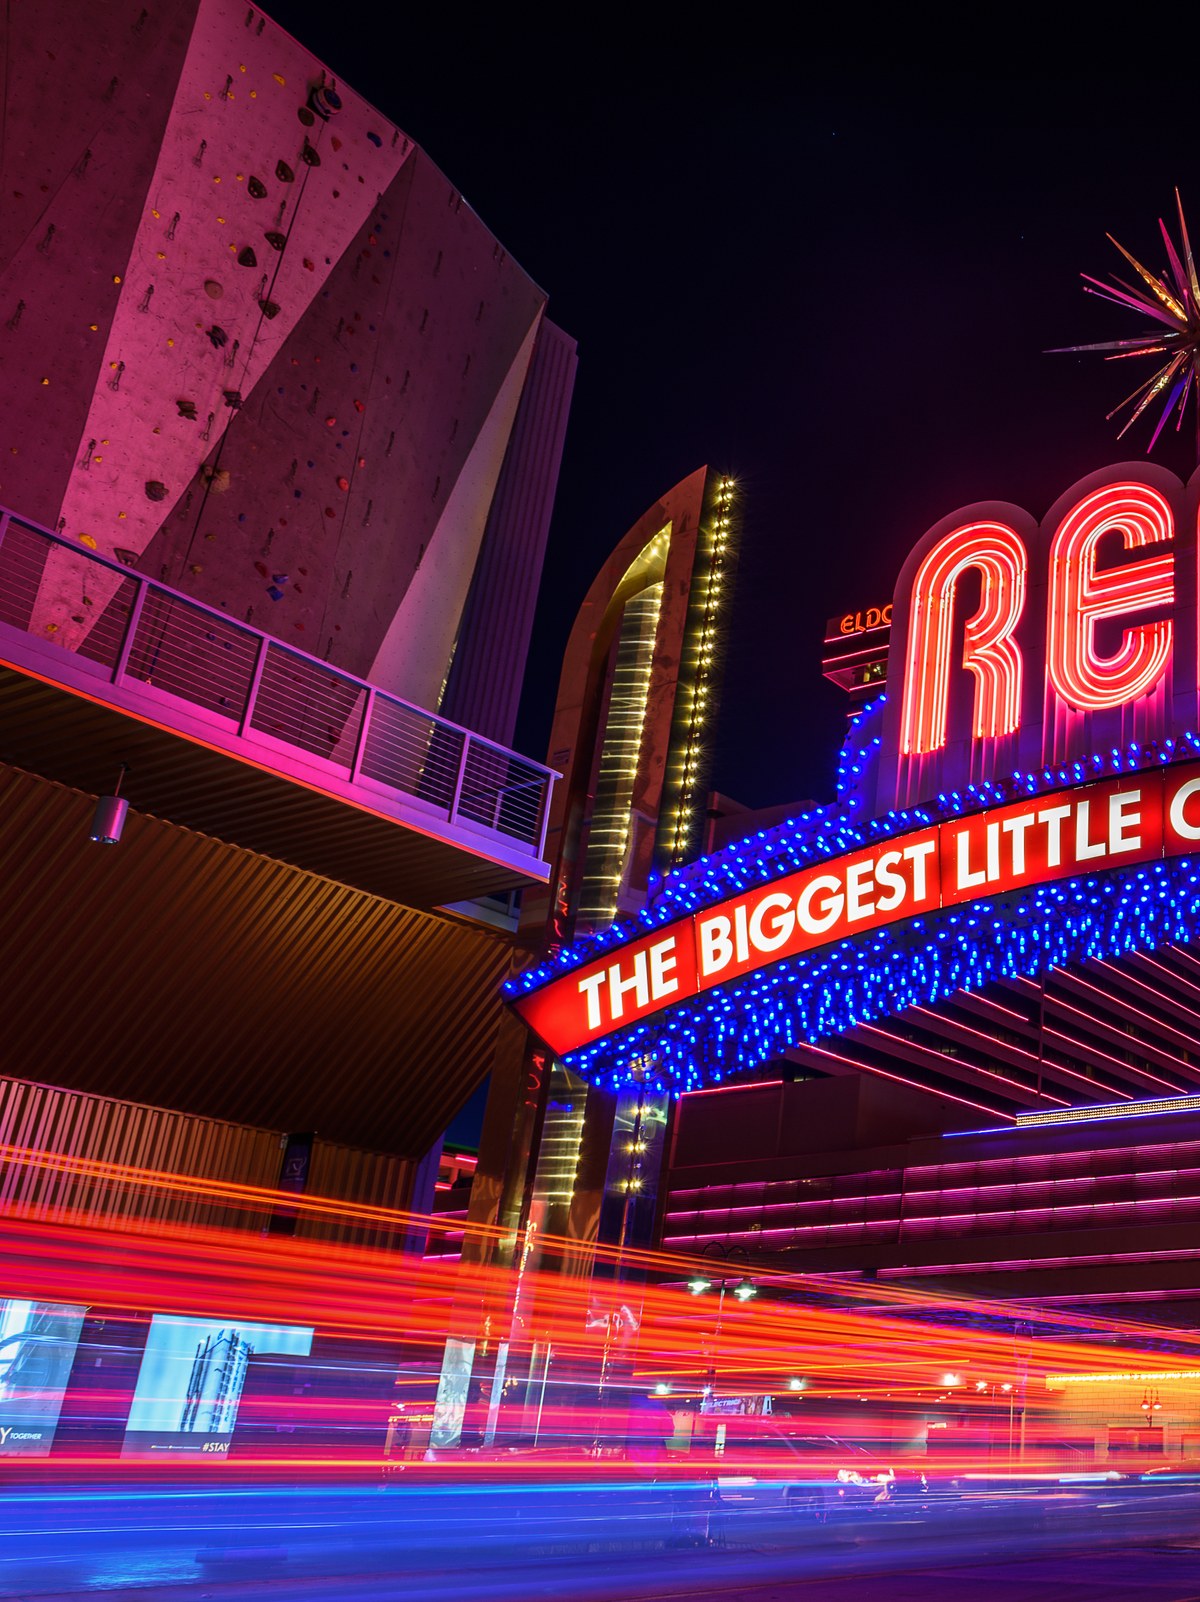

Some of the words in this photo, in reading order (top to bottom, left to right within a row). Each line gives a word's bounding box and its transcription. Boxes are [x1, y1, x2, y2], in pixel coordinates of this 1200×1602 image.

[578, 936, 679, 1030] THE
[698, 841, 936, 978] BIGGEST
[956, 789, 1142, 892] LITTLE
[9, 1431, 42, 1441] TOGETHER
[202, 1441, 231, 1454] #STAY
